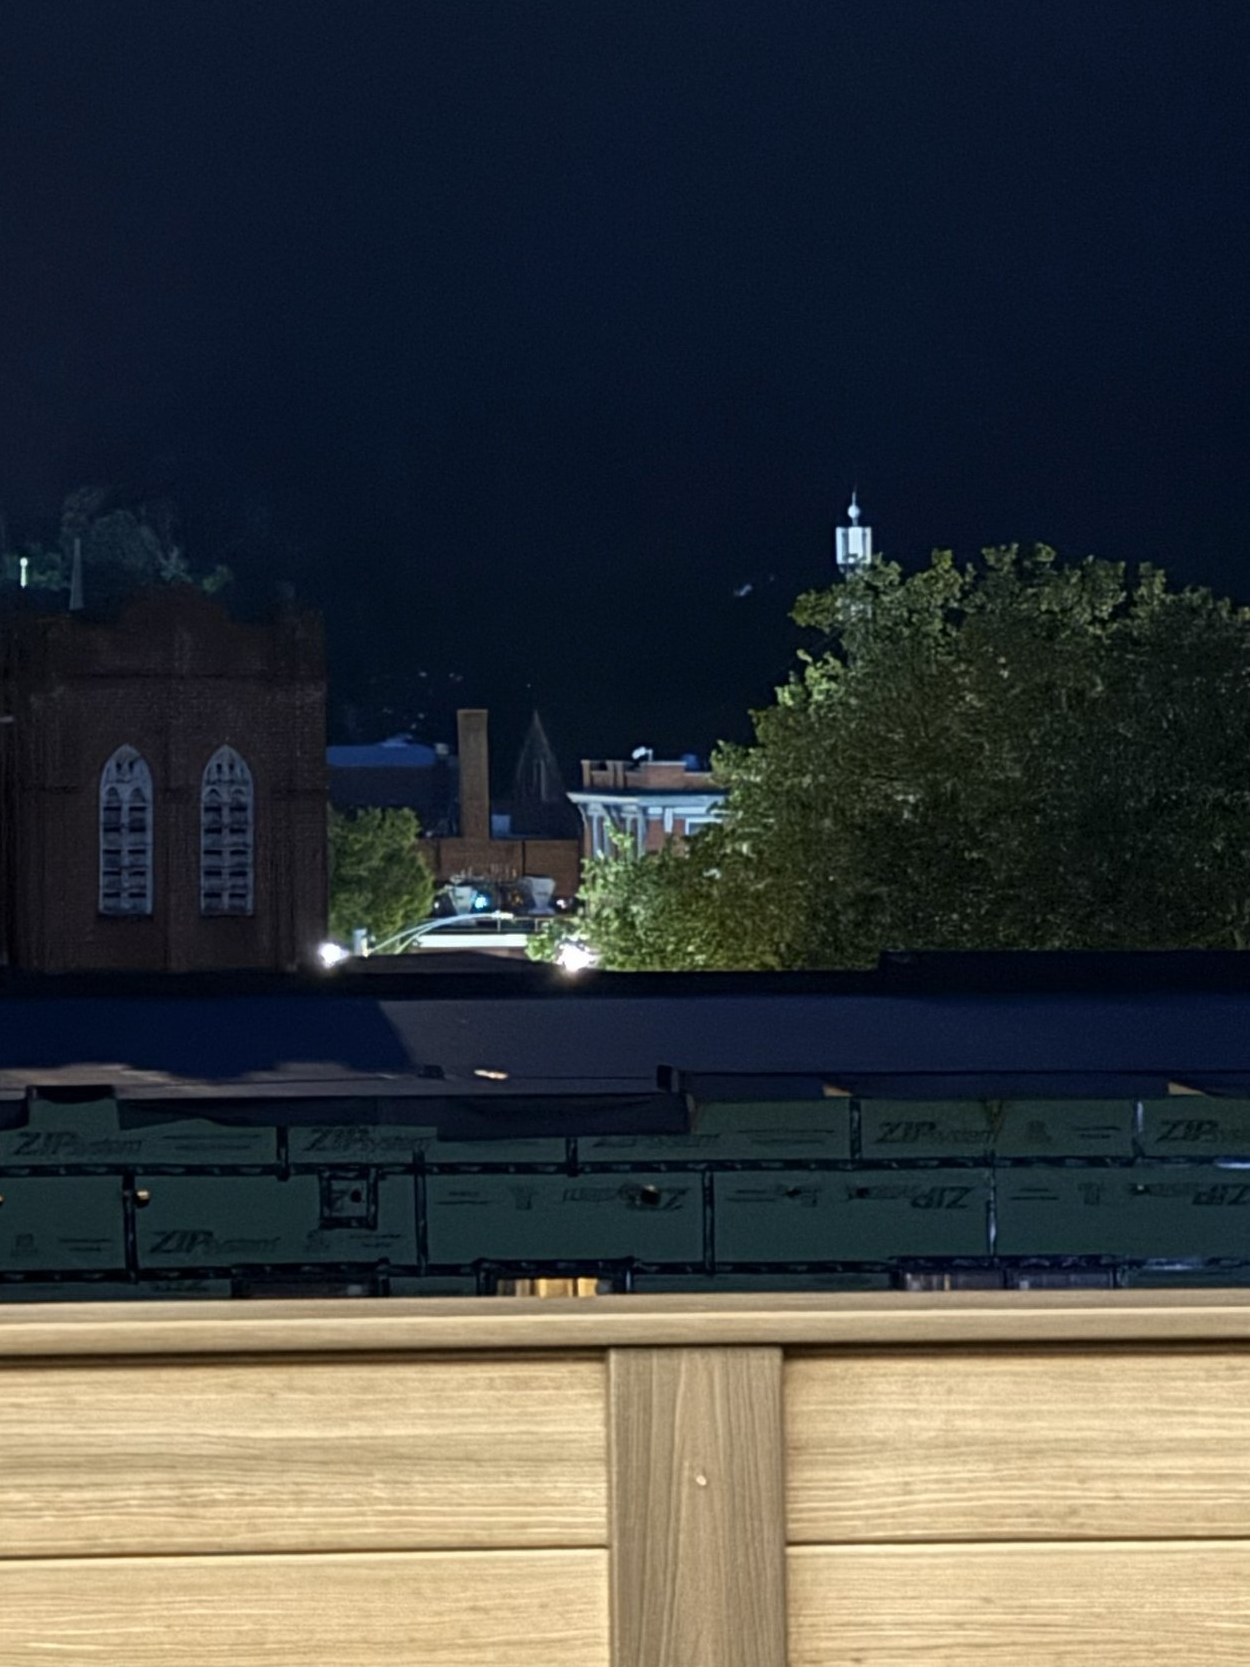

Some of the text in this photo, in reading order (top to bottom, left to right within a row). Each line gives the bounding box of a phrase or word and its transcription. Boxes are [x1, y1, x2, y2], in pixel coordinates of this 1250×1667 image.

[875, 1120, 937, 1144] ZIP
[1155, 1119, 1219, 1142] ZIP
[13, 1131, 78, 1156] ZIP
[910, 1186, 976, 1209] ZIP
[149, 1230, 215, 1254] ZIP
